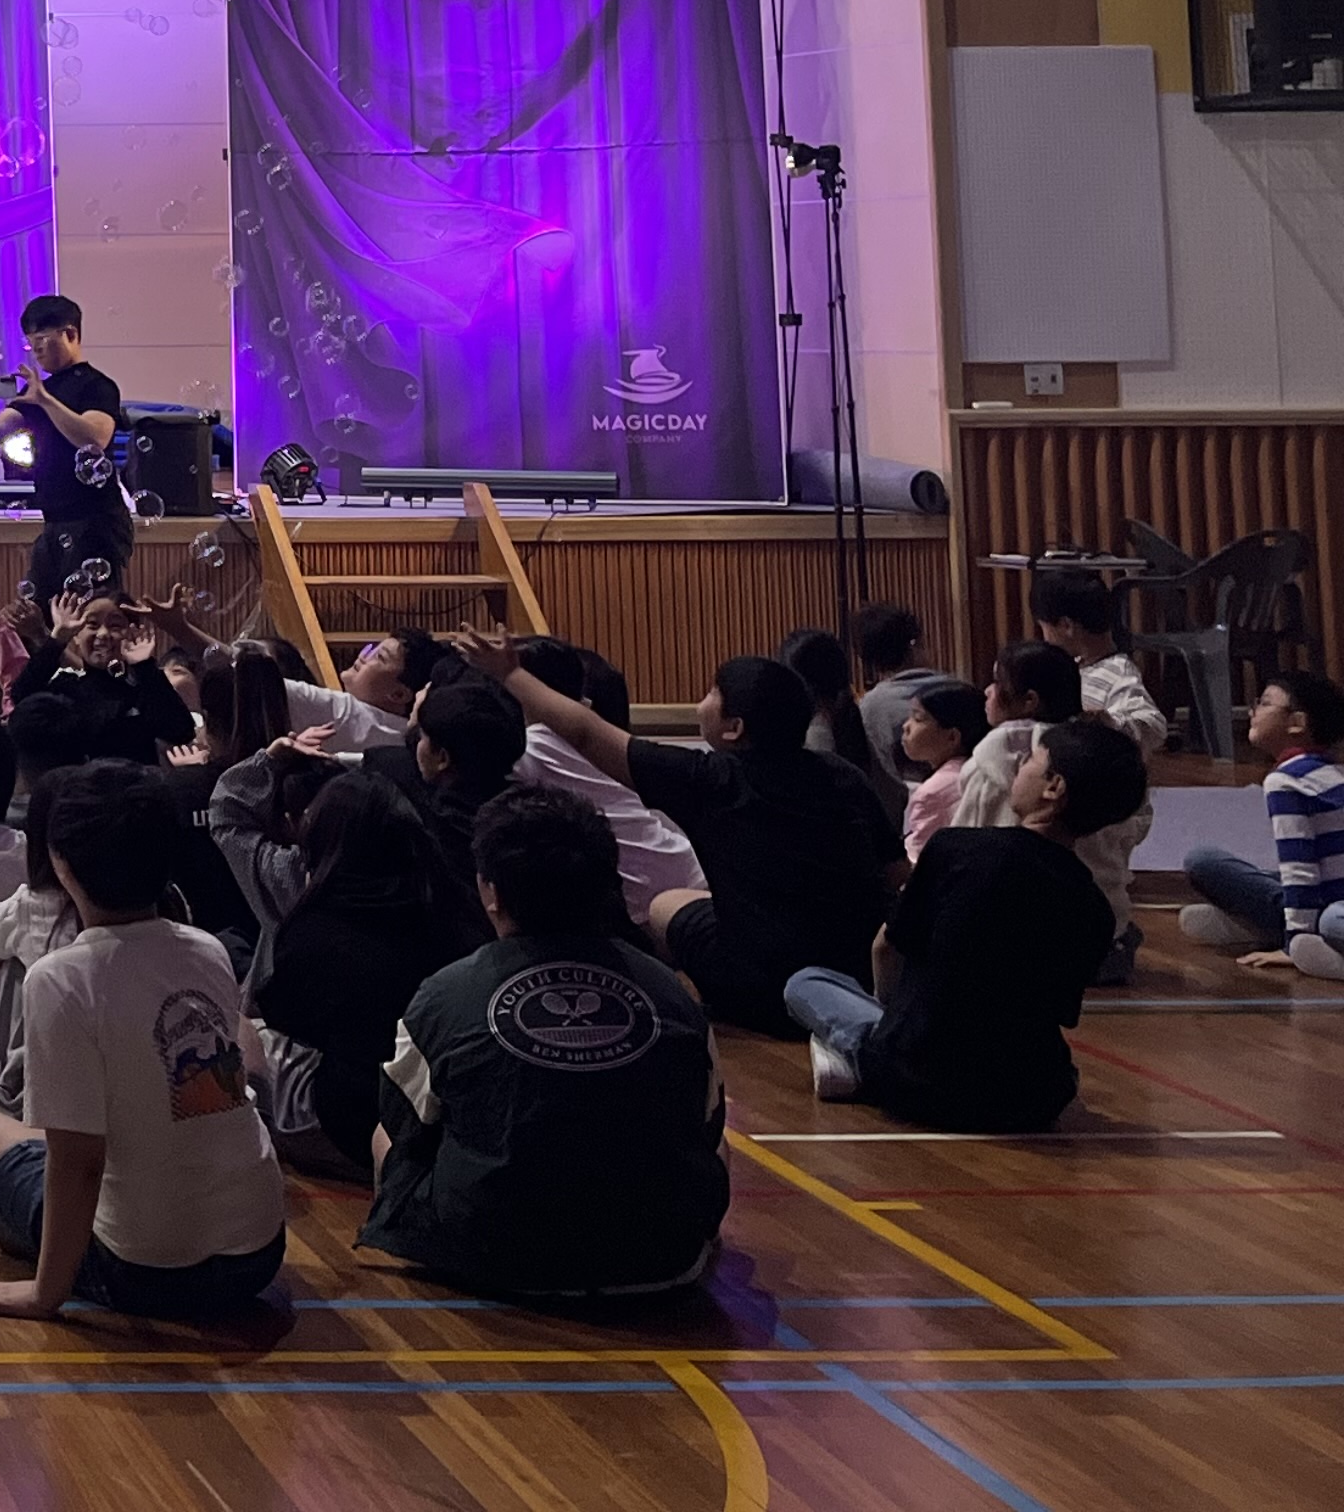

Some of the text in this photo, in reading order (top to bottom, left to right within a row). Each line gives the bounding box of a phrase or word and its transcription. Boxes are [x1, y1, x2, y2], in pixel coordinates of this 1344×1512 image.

[591, 413, 708, 431] MAGICDAY
[625, 434, 681, 444] COMPANY
[496, 968, 647, 1016] YOUTH CULTURE
[531, 1043, 561, 1058] BEN
